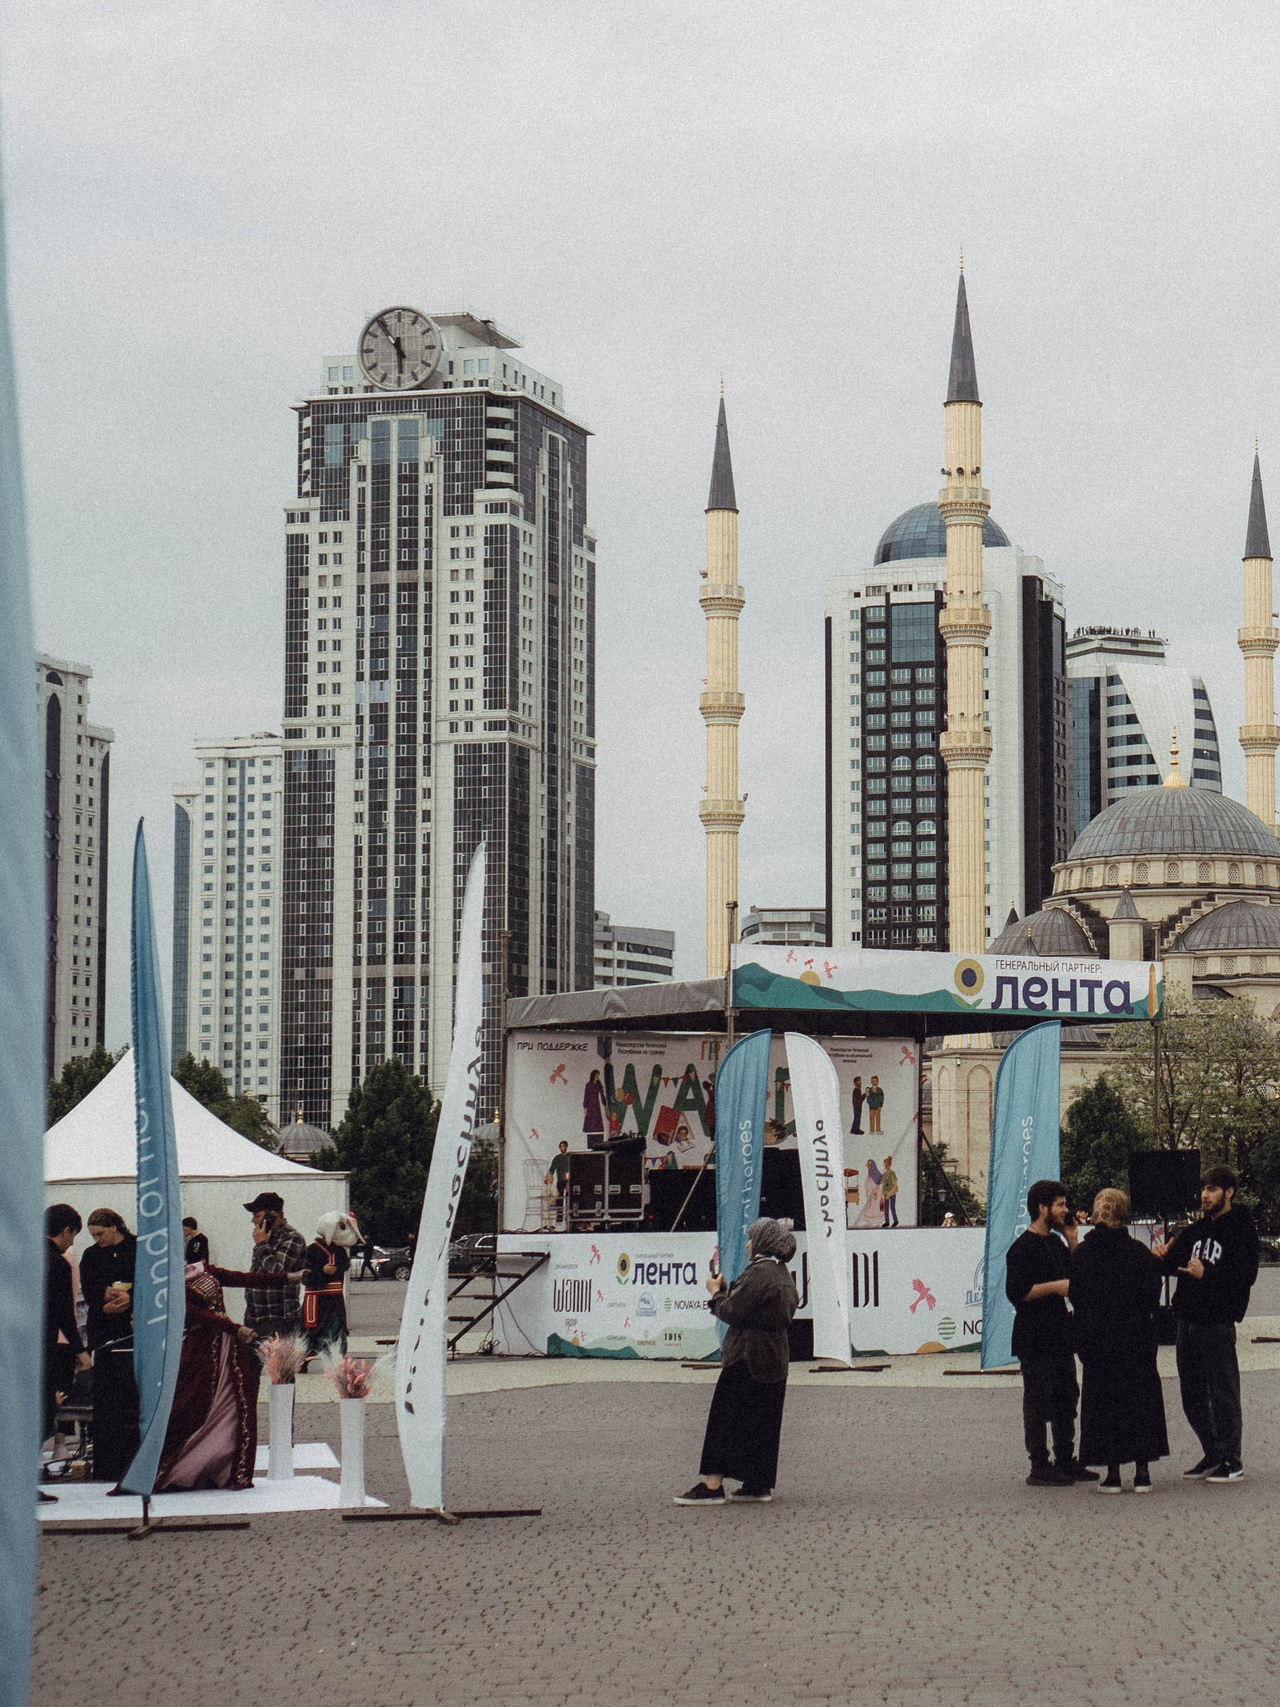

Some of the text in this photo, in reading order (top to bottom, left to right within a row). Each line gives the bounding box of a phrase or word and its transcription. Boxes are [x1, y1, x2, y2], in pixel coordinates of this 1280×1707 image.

[995, 959, 1103, 974] ГЕНЕРАЛЬНЫЙ ПАРТНЕР:
[991, 975, 1134, 1014] лента
[516, 1041, 589, 1052] ПРИ ПОДДЕРЖКЕ
[738, 1119, 754, 1193] heroes
[1190, 1237, 1223, 1265] GAP
[632, 1261, 698, 1286] лента
[674, 1300, 701, 1311] NOVAYA
